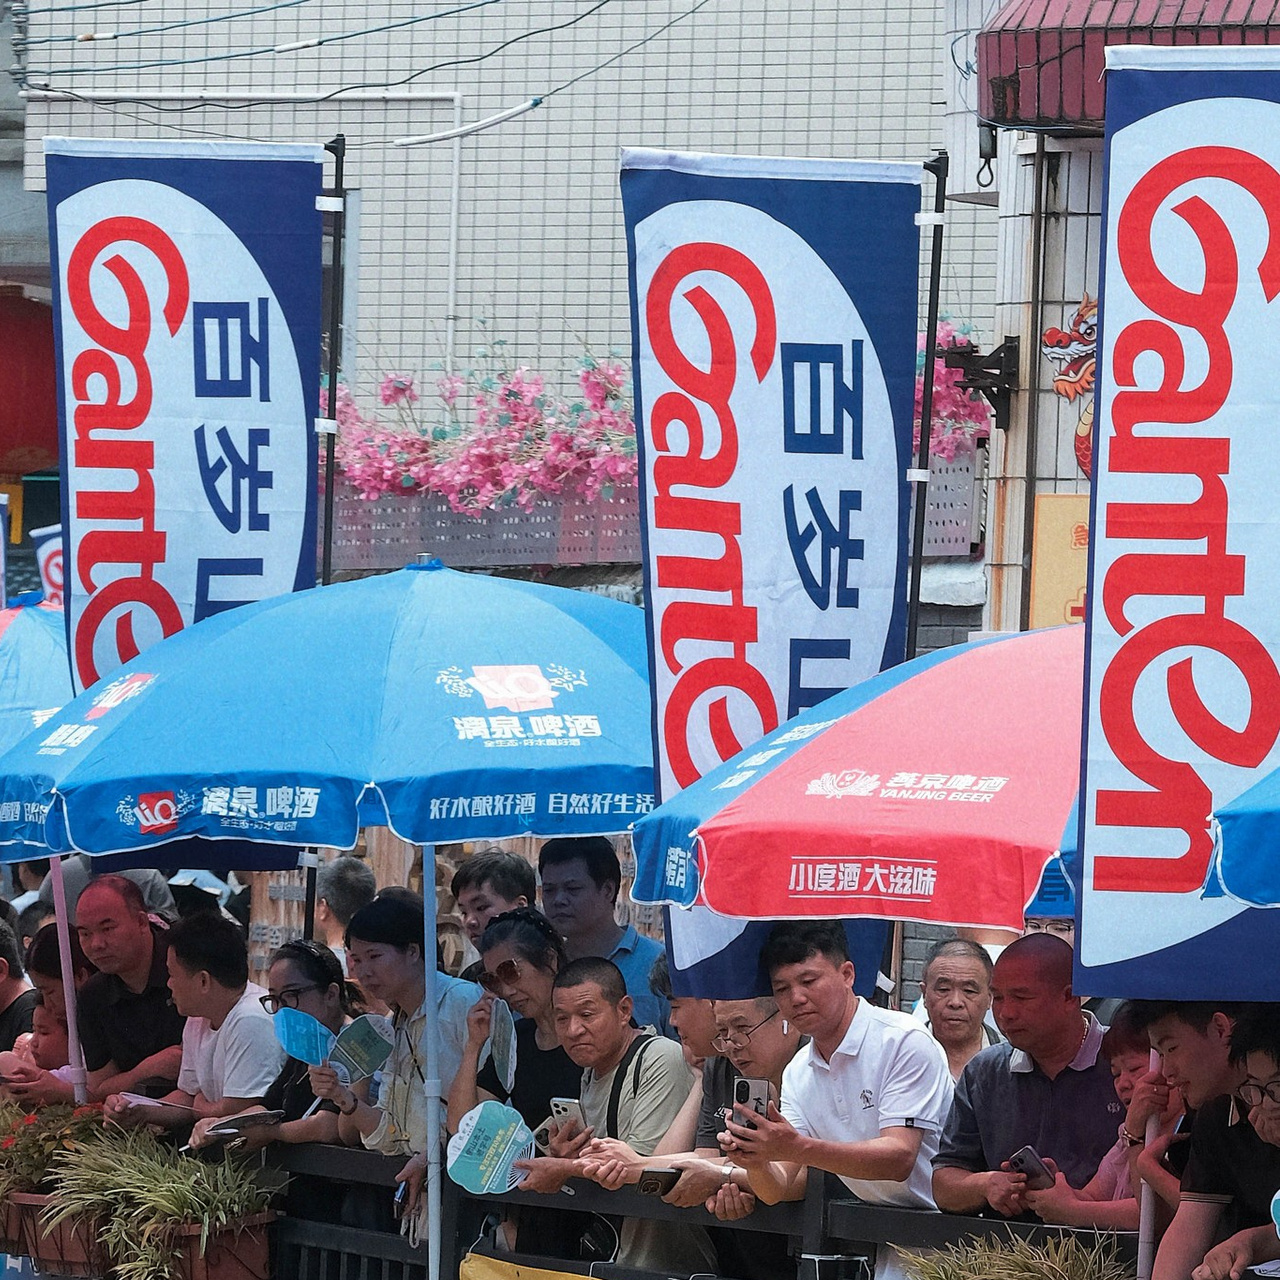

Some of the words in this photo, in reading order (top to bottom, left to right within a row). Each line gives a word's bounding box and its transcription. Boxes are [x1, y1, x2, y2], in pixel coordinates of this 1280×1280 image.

[66, 215, 190, 693] Gante
[645, 241, 780, 791] Gante
[879, 788, 948, 802] YANJING
[952, 791, 995, 803] BEER
[885, 771, 1010, 793] 燕京啤酒
[429, 793, 537, 820] 好水酿好酒
[548, 792, 655, 816] 自然好生活
[788, 862, 862, 893] 小度酒
[864, 863, 938, 896] 大滋味
